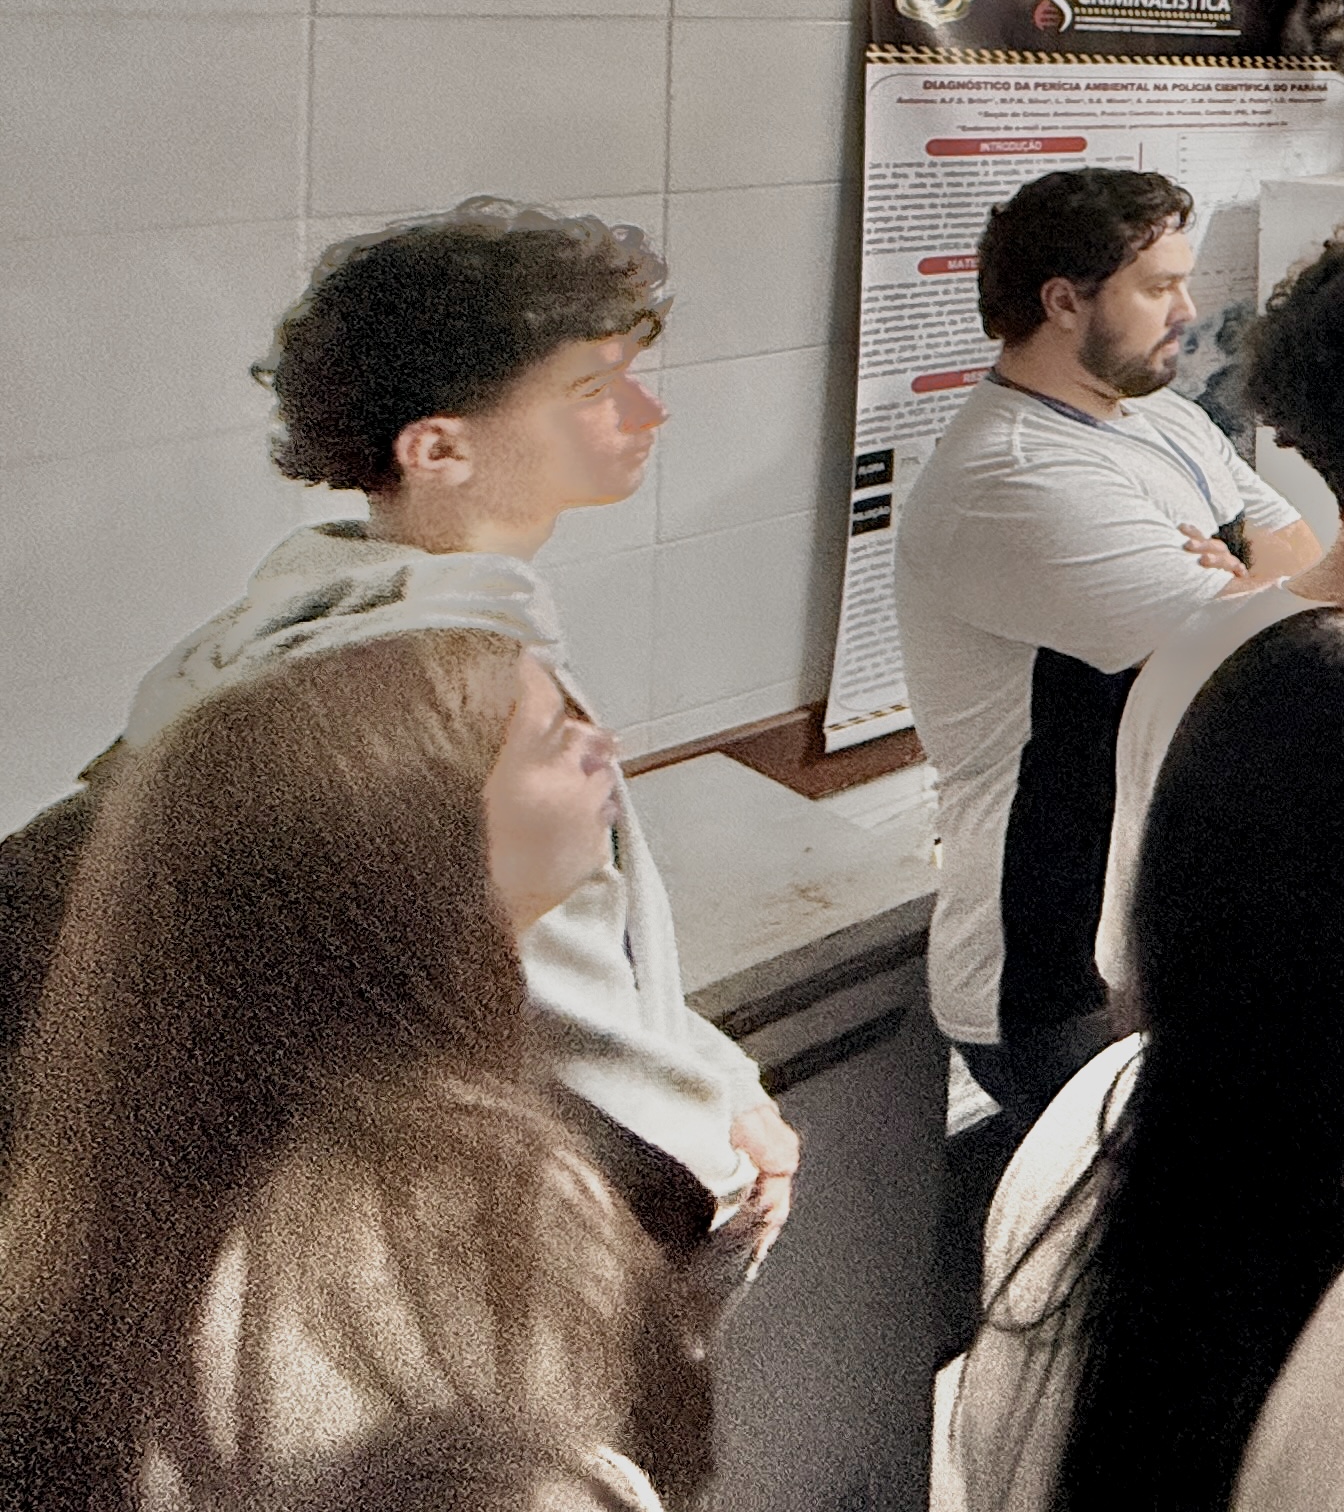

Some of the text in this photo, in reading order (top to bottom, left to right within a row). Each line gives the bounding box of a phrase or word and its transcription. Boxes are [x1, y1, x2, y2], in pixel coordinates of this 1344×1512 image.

[922, 79, 1012, 92] DIAGNÓSTICO
[1014, 82, 1031, 92] DA
[1084, 82, 1150, 92] AMBIENTAL
[1153, 83, 1168, 92] NA
